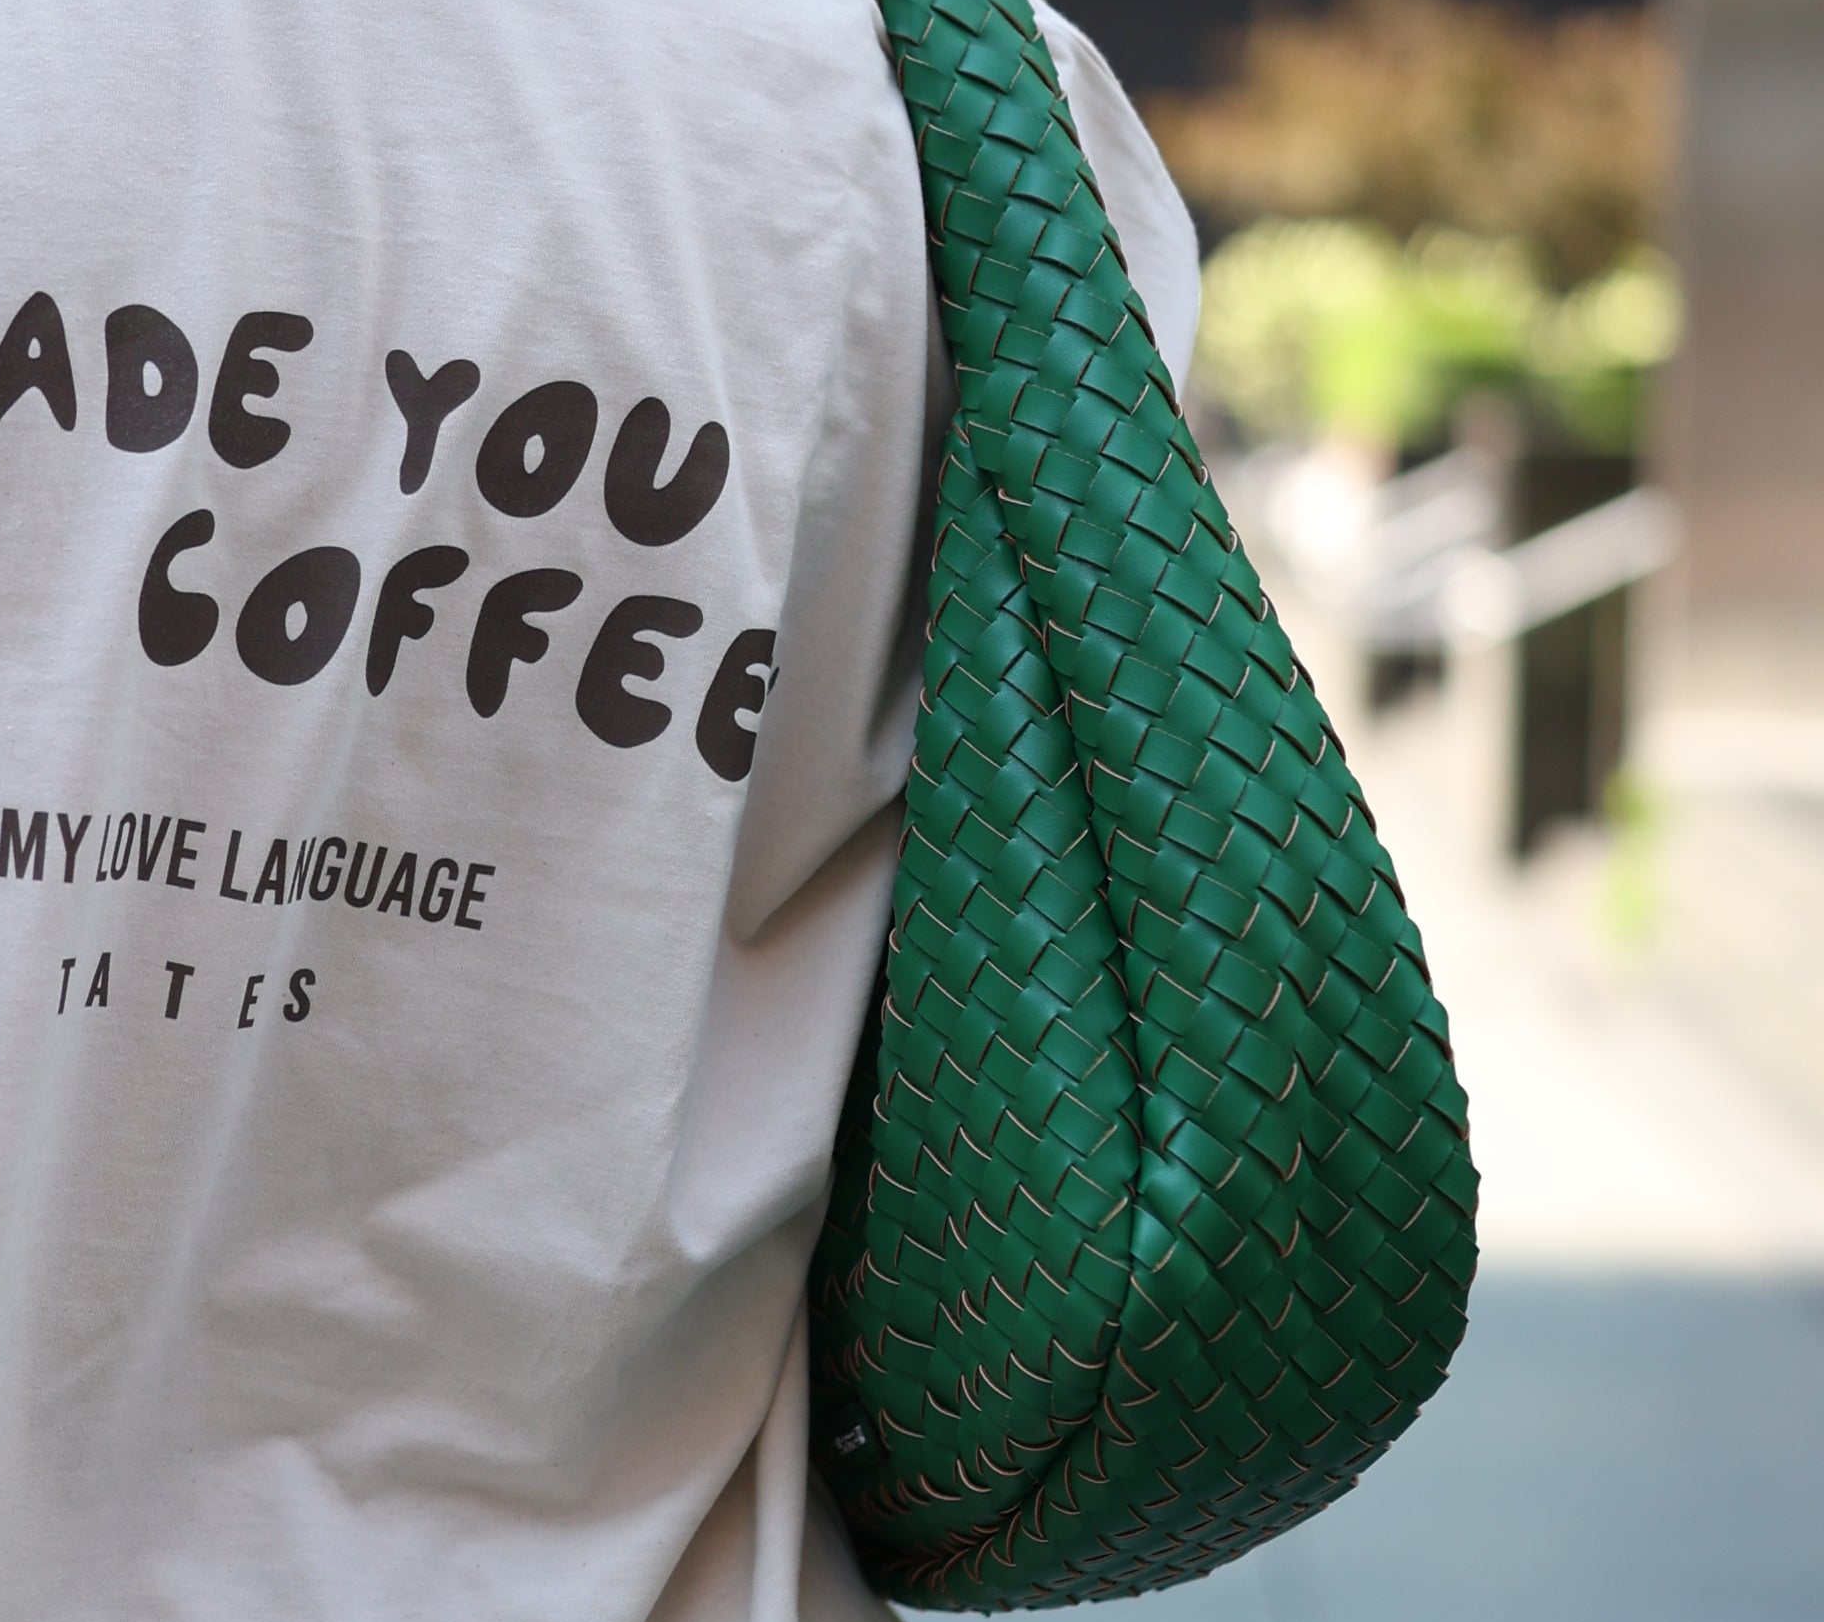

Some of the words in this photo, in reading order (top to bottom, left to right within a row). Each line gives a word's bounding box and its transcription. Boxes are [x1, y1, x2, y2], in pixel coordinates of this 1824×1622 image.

[384, 349, 730, 548] YOU
[137, 508, 781, 783] COFFEE
[95, 812, 207, 890] LOVE
[219, 829, 497, 931] LANGUAGE
